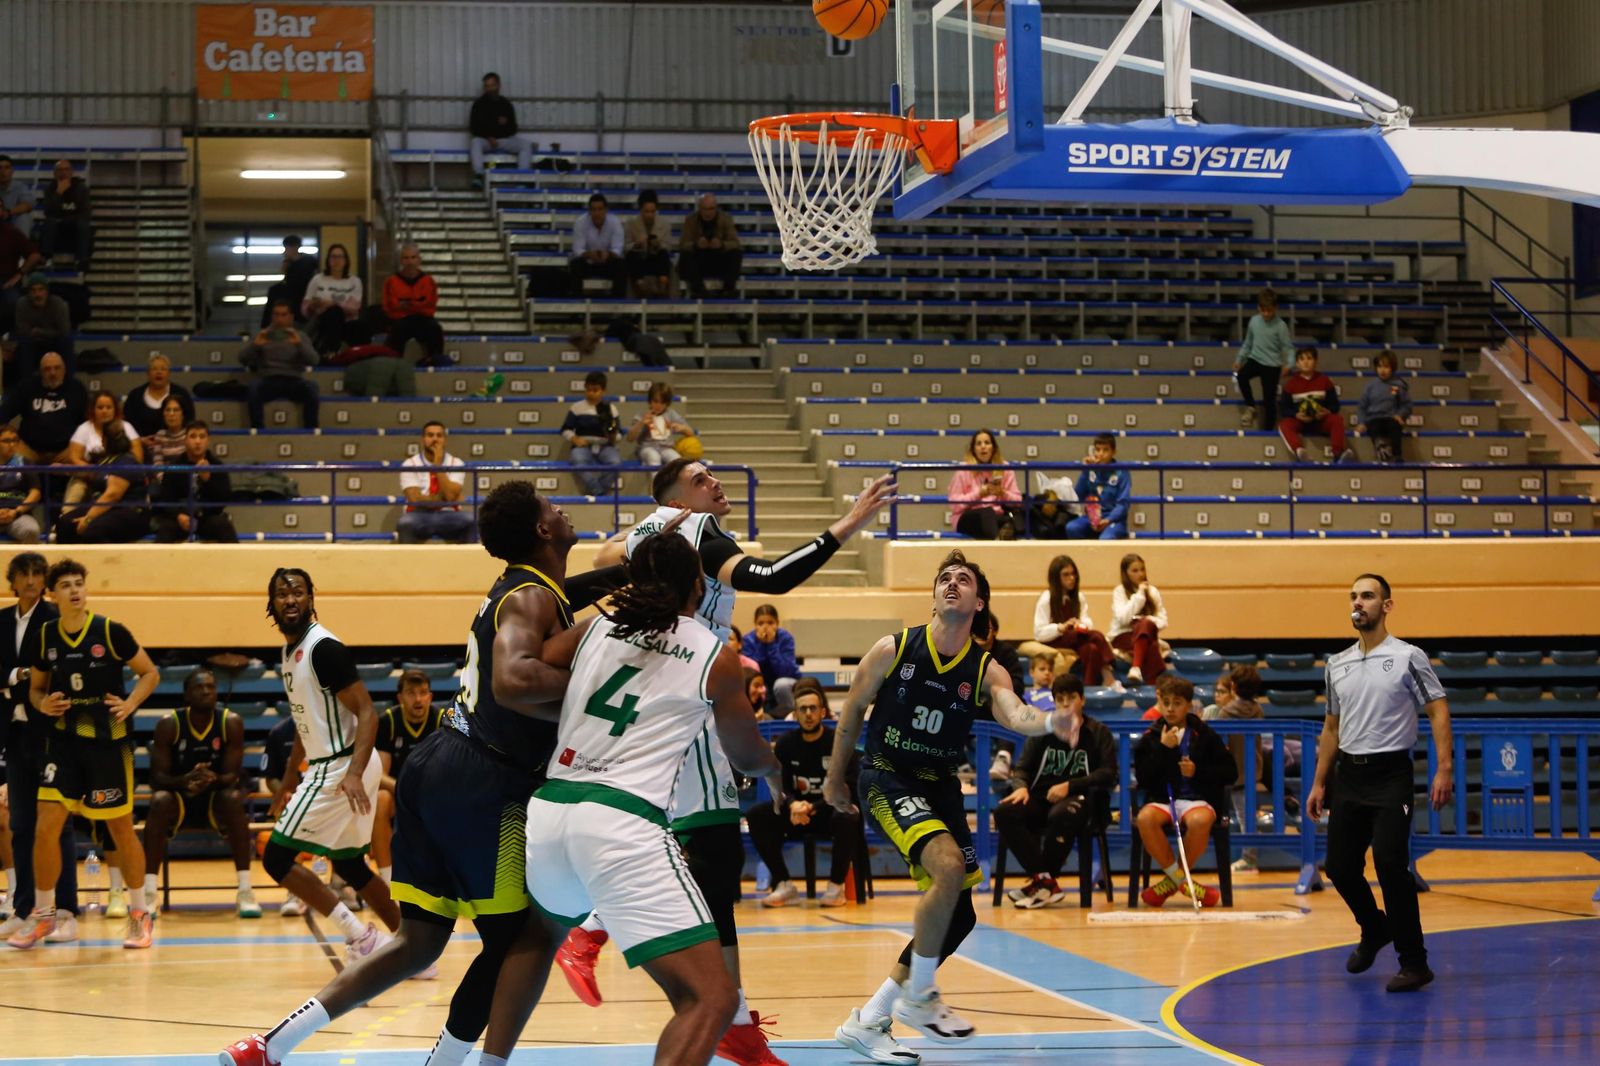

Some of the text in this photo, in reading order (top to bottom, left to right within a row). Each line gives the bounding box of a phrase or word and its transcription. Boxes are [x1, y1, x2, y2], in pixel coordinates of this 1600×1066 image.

[254, 8, 316, 38] Bar
[203, 40, 366, 74] Cafetería
[1068, 142, 1292, 173] SPORT SYSTEM
[70, 672, 84, 691] 6
[584, 663, 644, 738] 4
[911, 705, 944, 735] 30
[43, 762, 58, 783] 6
